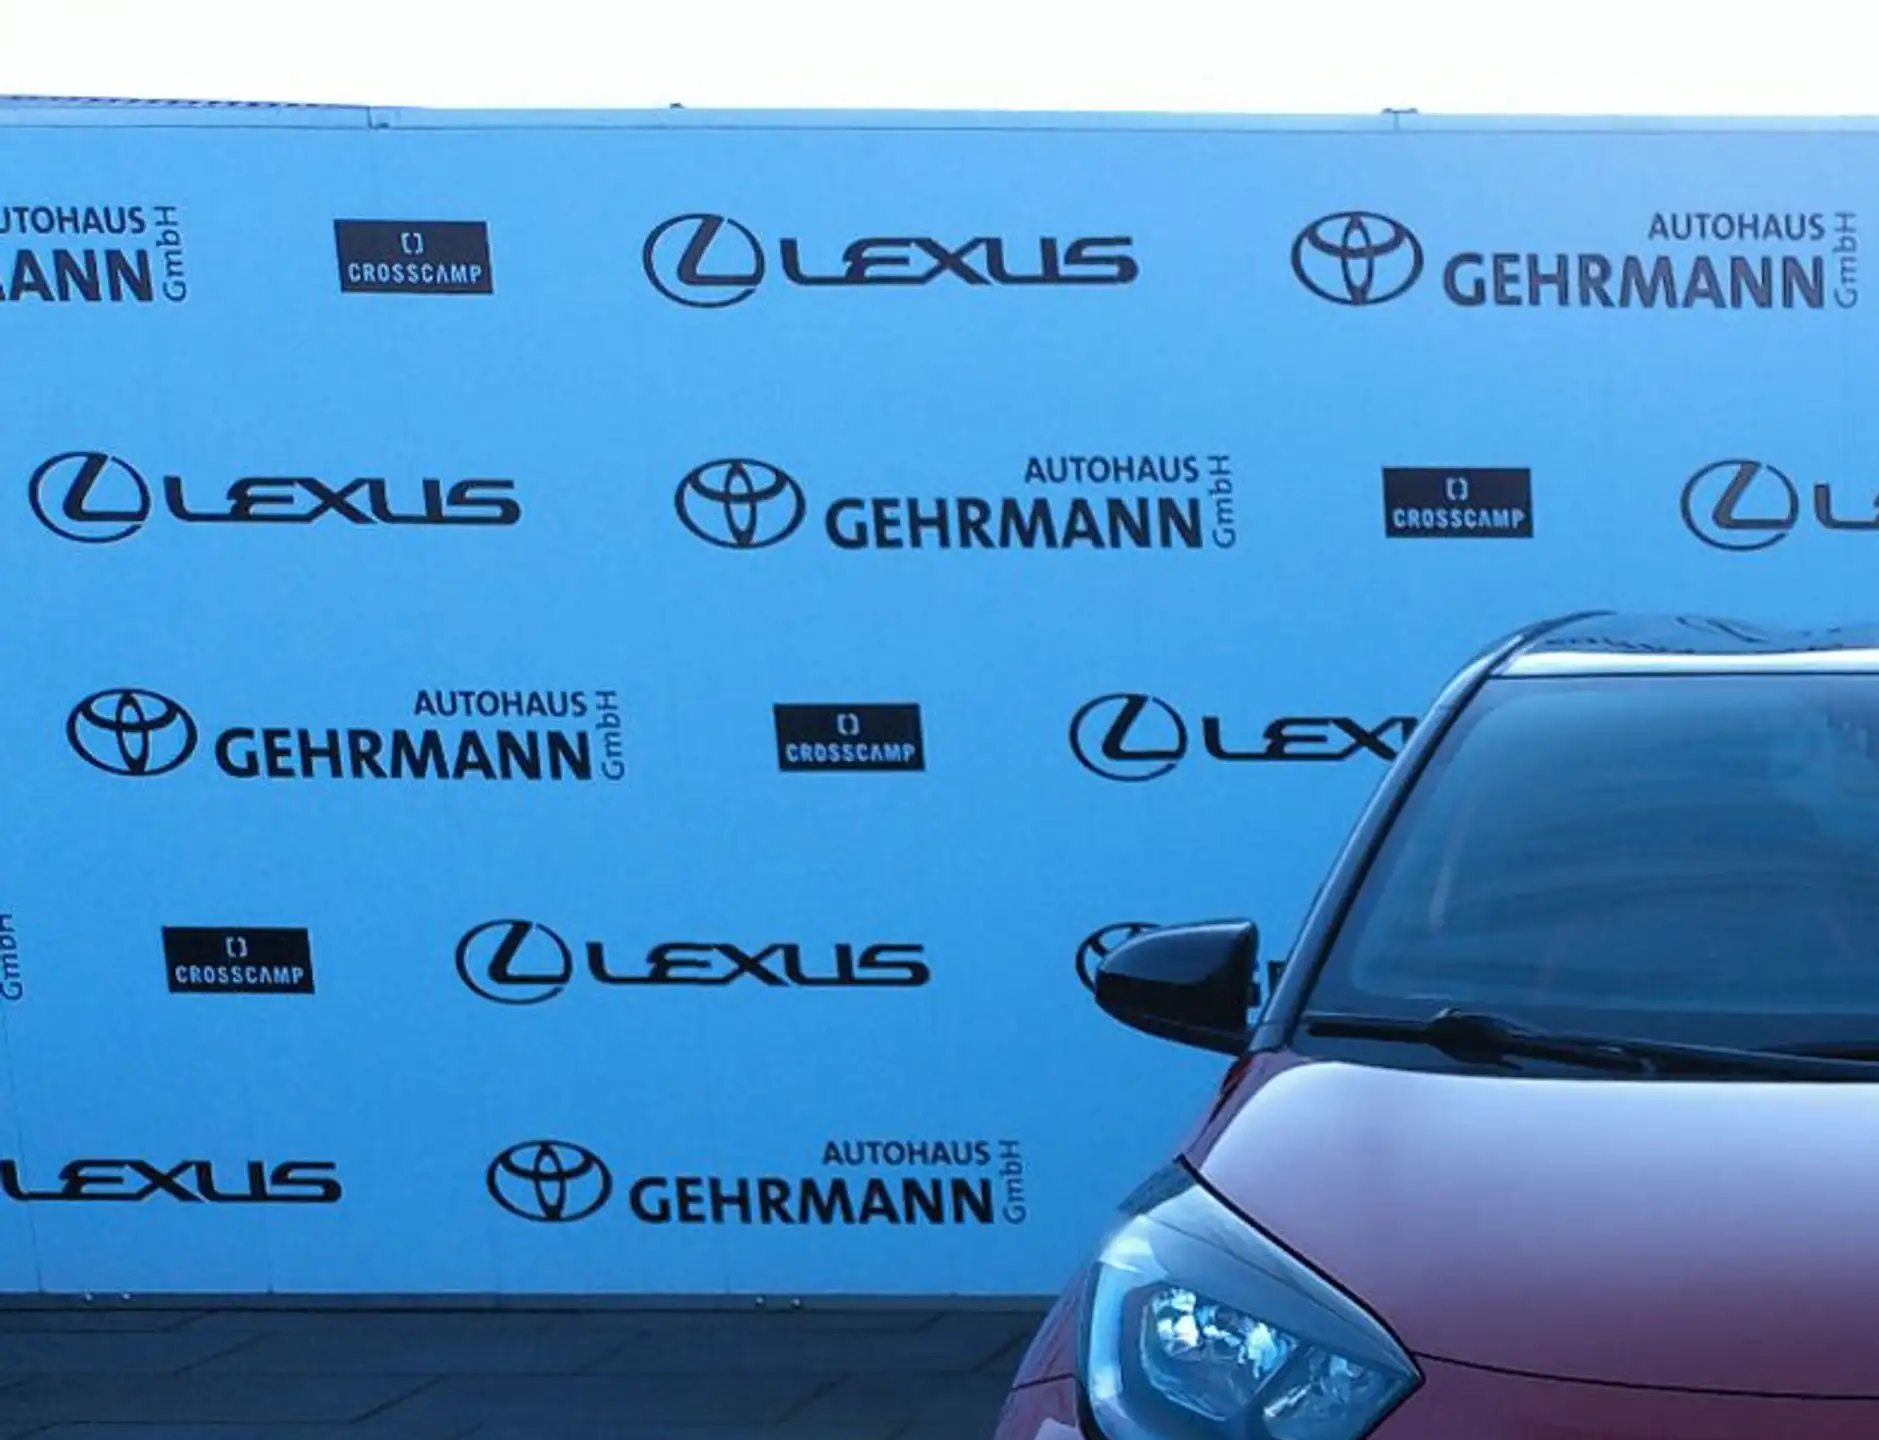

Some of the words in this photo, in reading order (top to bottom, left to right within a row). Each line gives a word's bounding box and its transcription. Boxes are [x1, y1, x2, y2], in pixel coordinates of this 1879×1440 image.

[1648, 212, 1826, 241] AUTOHAUS
[348, 262, 482, 285] CROSSCAMP
[779, 236, 1140, 287] LEXUS
[1442, 252, 1825, 310] GEHRMANN
[1832, 211, 1859, 310] GmbH
[1024, 455, 1200, 485] AUTOHAUS
[163, 475, 521, 526] LEXUS
[825, 497, 1203, 550] GEHRMANN
[1206, 454, 1237, 549] GmbH
[1392, 508, 1526, 530] CROSSCAMP
[414, 689, 588, 718] AUTOHAUS
[214, 727, 592, 782] GEHRMANN
[599, 689, 626, 781] GmbH
[785, 742, 915, 764] CROSSCAMP
[175, 964, 304, 986] CROSSCAMP
[585, 942, 931, 988] LEXUS
[822, 1140, 991, 1167] AUTOHAUS
[0, 1159, 342, 1204] LEXUS
[629, 1176, 994, 1226] GEHRMANN
